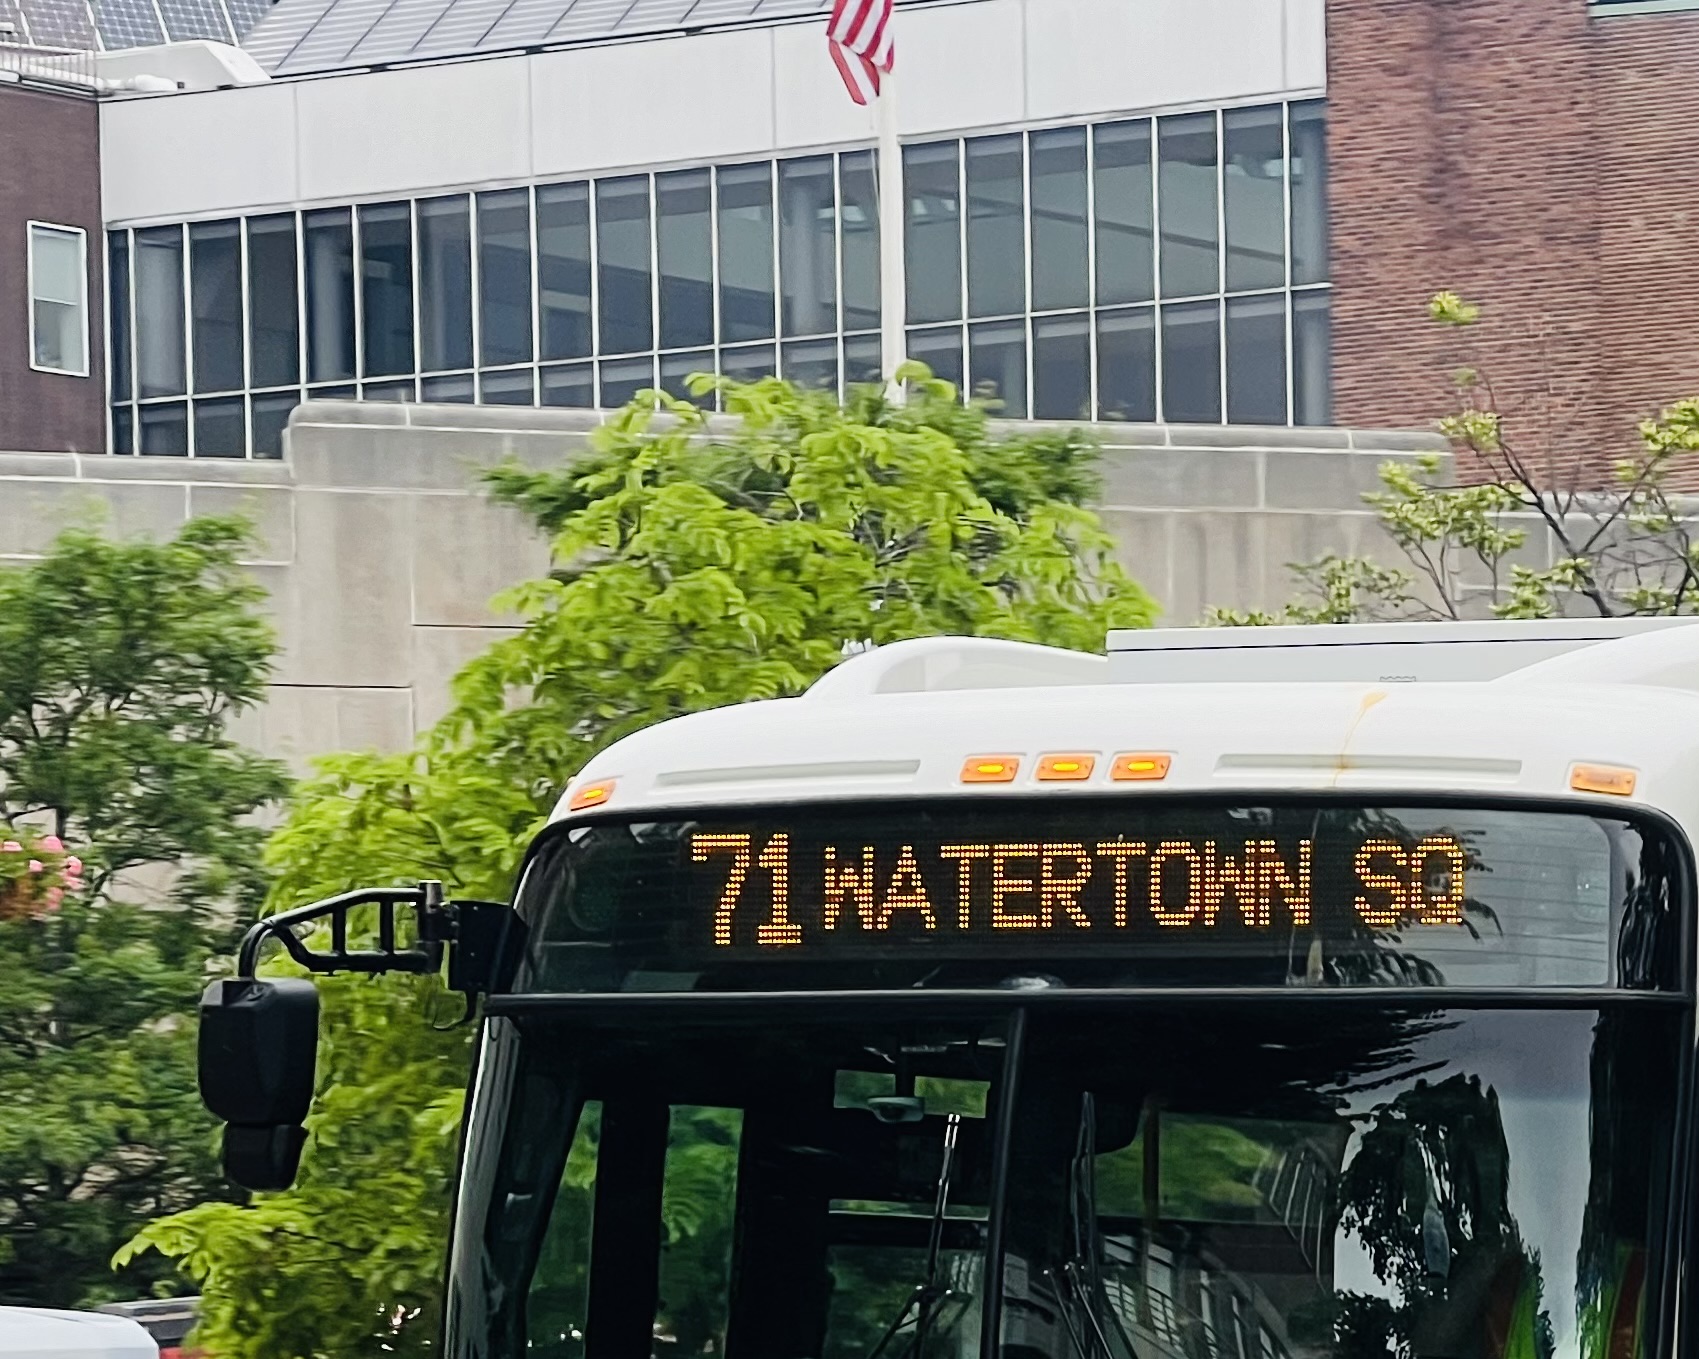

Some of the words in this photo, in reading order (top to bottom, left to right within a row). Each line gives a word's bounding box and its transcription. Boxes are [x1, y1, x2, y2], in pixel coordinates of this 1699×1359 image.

[691, 833, 802, 945] 71
[823, 839, 1313, 931] WATERTOWN
[1354, 836, 1464, 926] SQ
